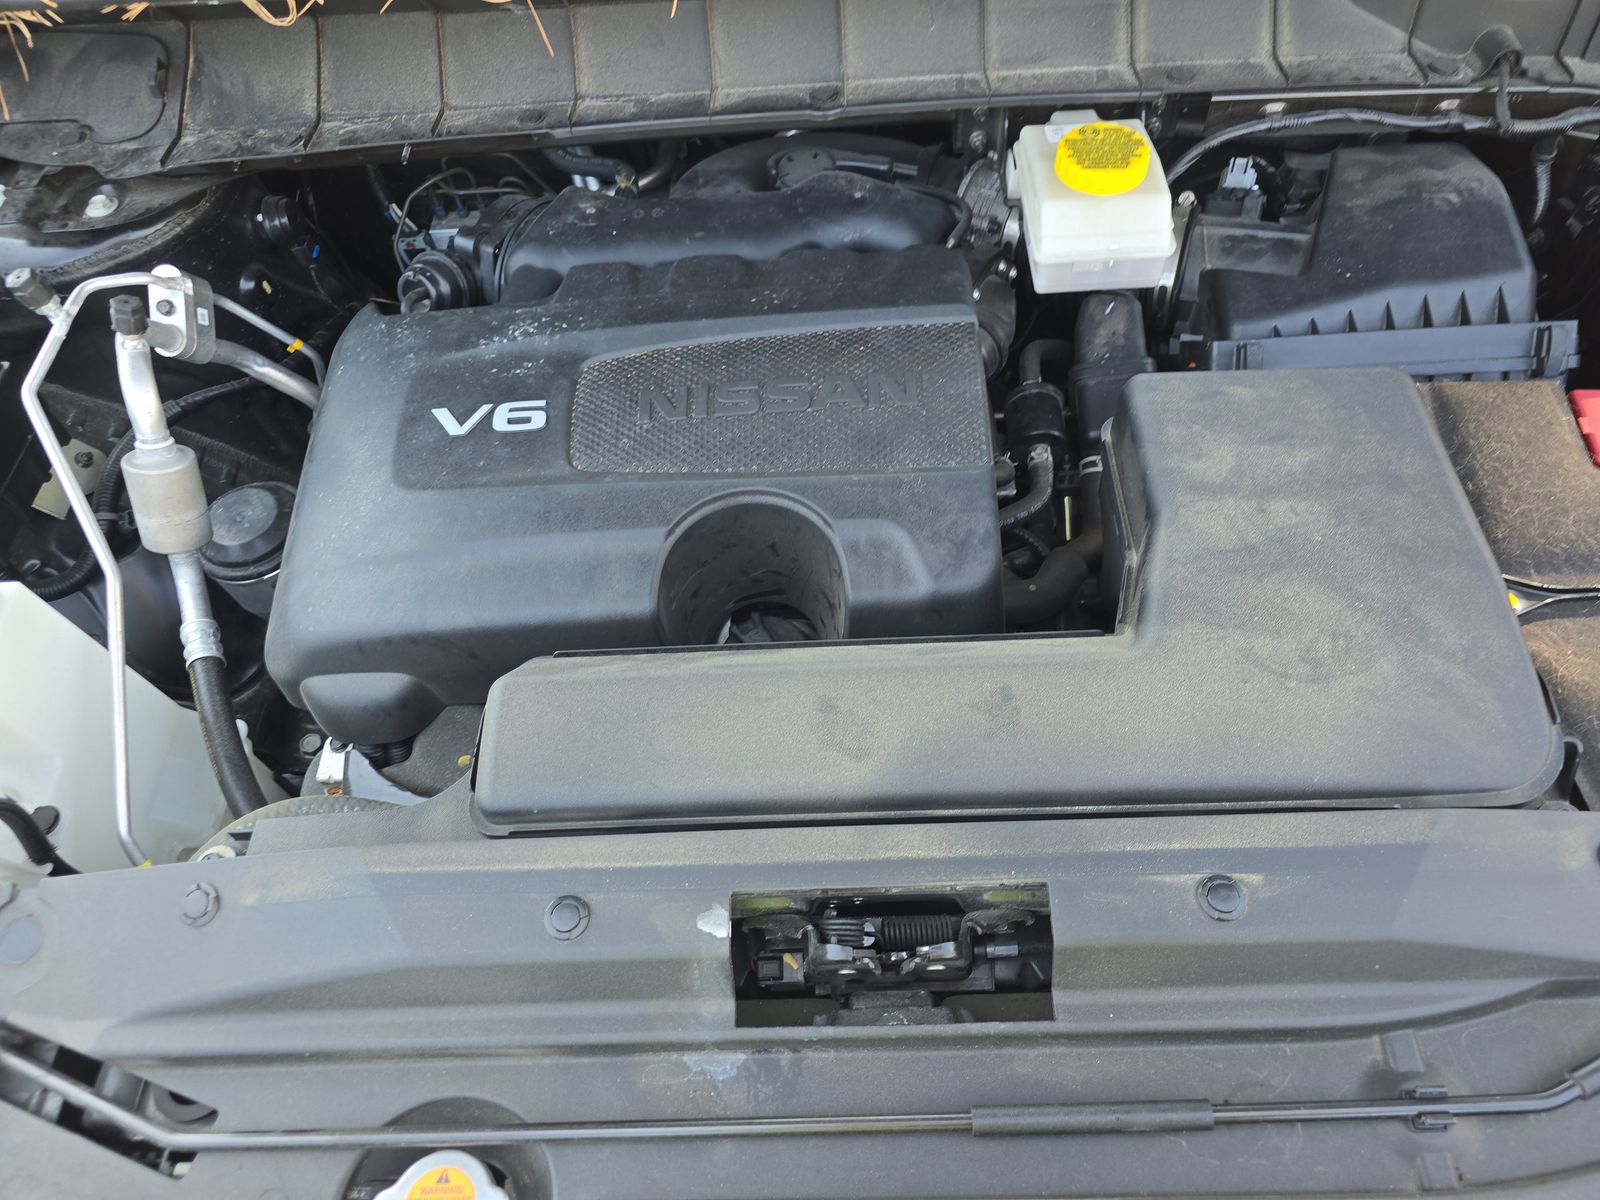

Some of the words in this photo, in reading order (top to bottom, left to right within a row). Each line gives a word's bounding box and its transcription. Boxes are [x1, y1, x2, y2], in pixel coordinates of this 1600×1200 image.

[431, 399, 548, 437] V6
[639, 375, 918, 424] NISSAN
[420, 1184, 464, 1195] WARNING
